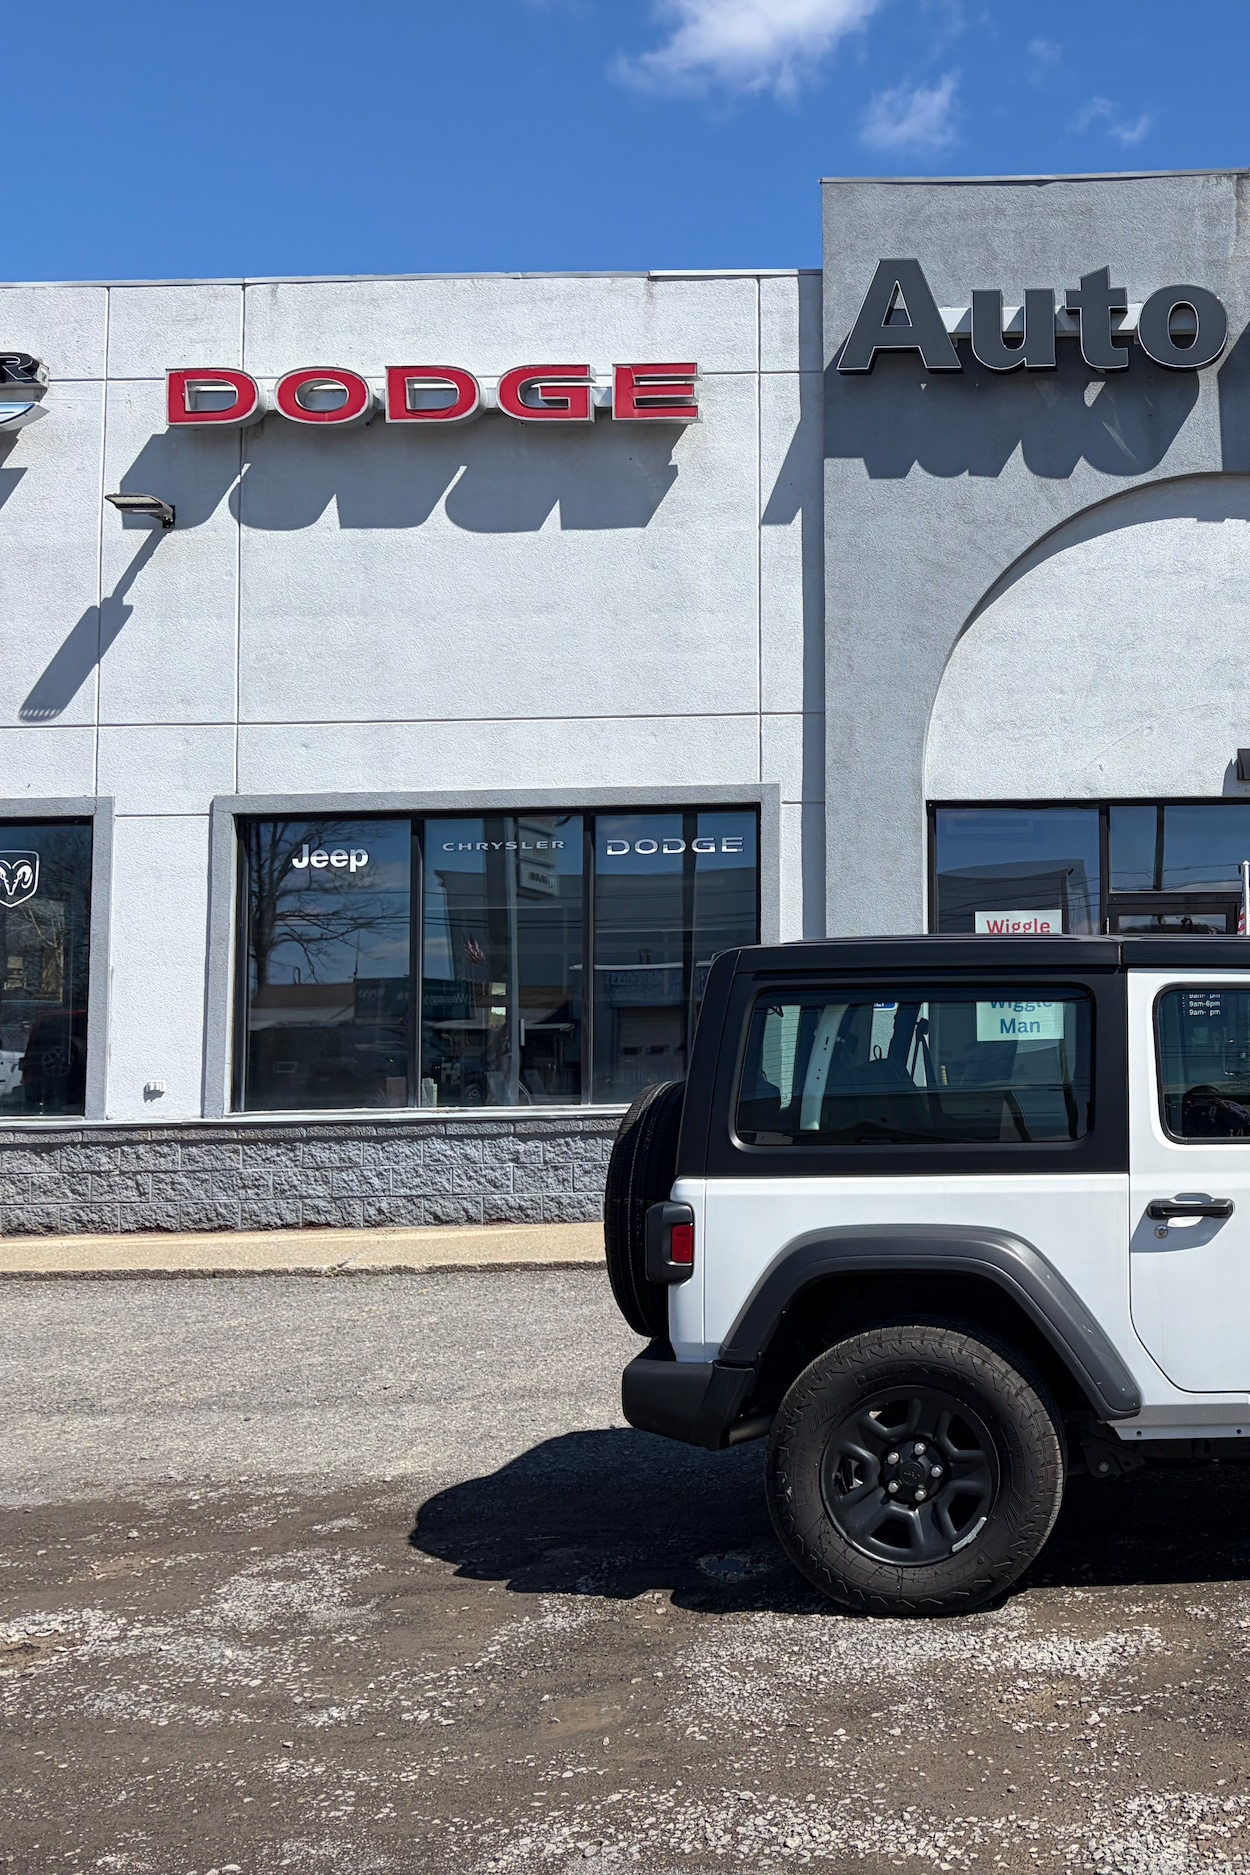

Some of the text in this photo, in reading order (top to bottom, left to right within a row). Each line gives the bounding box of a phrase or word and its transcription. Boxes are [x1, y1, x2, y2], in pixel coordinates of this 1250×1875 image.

[836, 258, 1228, 371] Auto
[166, 363, 700, 424] DODGE
[442, 840, 565, 851] CHRYSLER
[607, 837, 743, 855] DODGE
[292, 844, 368, 873] Jeep
[986, 918, 1051, 934] Wiggle
[1000, 1018, 1041, 1034] Man
